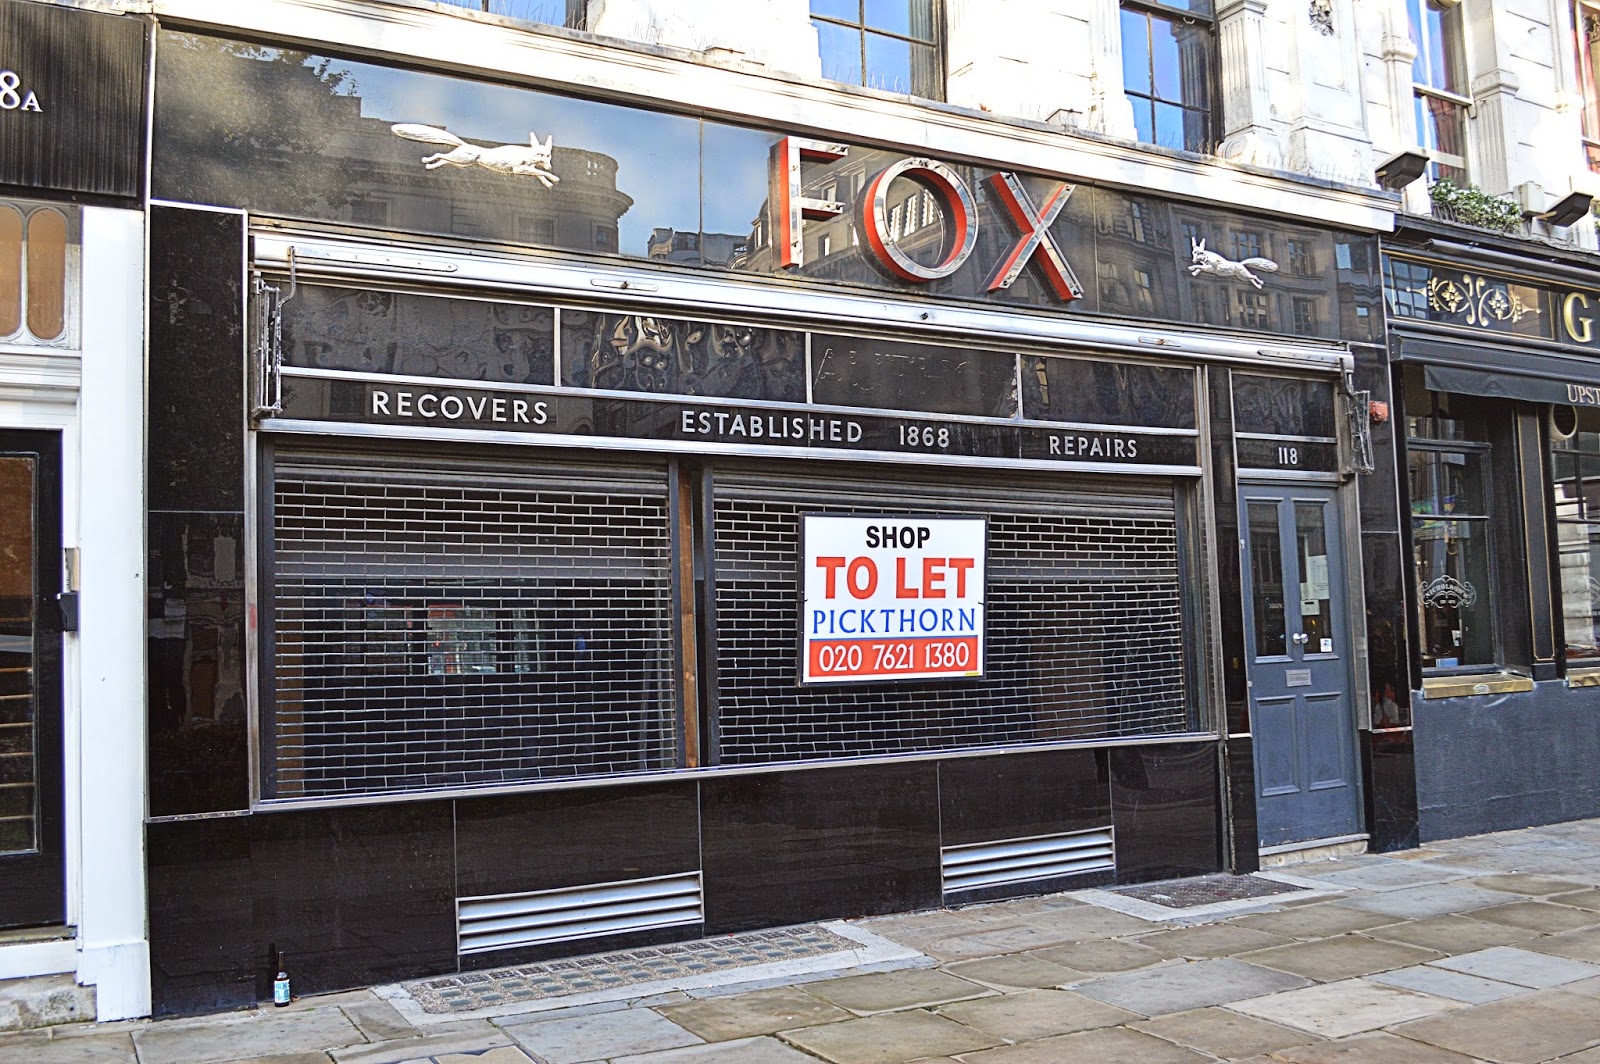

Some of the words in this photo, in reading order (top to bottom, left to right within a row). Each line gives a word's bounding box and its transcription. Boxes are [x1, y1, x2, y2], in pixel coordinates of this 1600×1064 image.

[779, 135, 1084, 301] FOX
[372, 390, 548, 425] RECOVERS
[682, 410, 863, 443] ESTABLISHED
[900, 425, 950, 448] 1868
[1049, 436, 1137, 458] REPAIRS
[1278, 447, 1298, 465] 118
[866, 525, 930, 549] SHOP
[816, 556, 878, 600] TO
[895, 557, 974, 599] LET
[813, 608, 975, 634] PICKTHORN
[819, 644, 863, 672] 020
[872, 643, 914, 670] 7621
[924, 641, 970, 668] 1380
